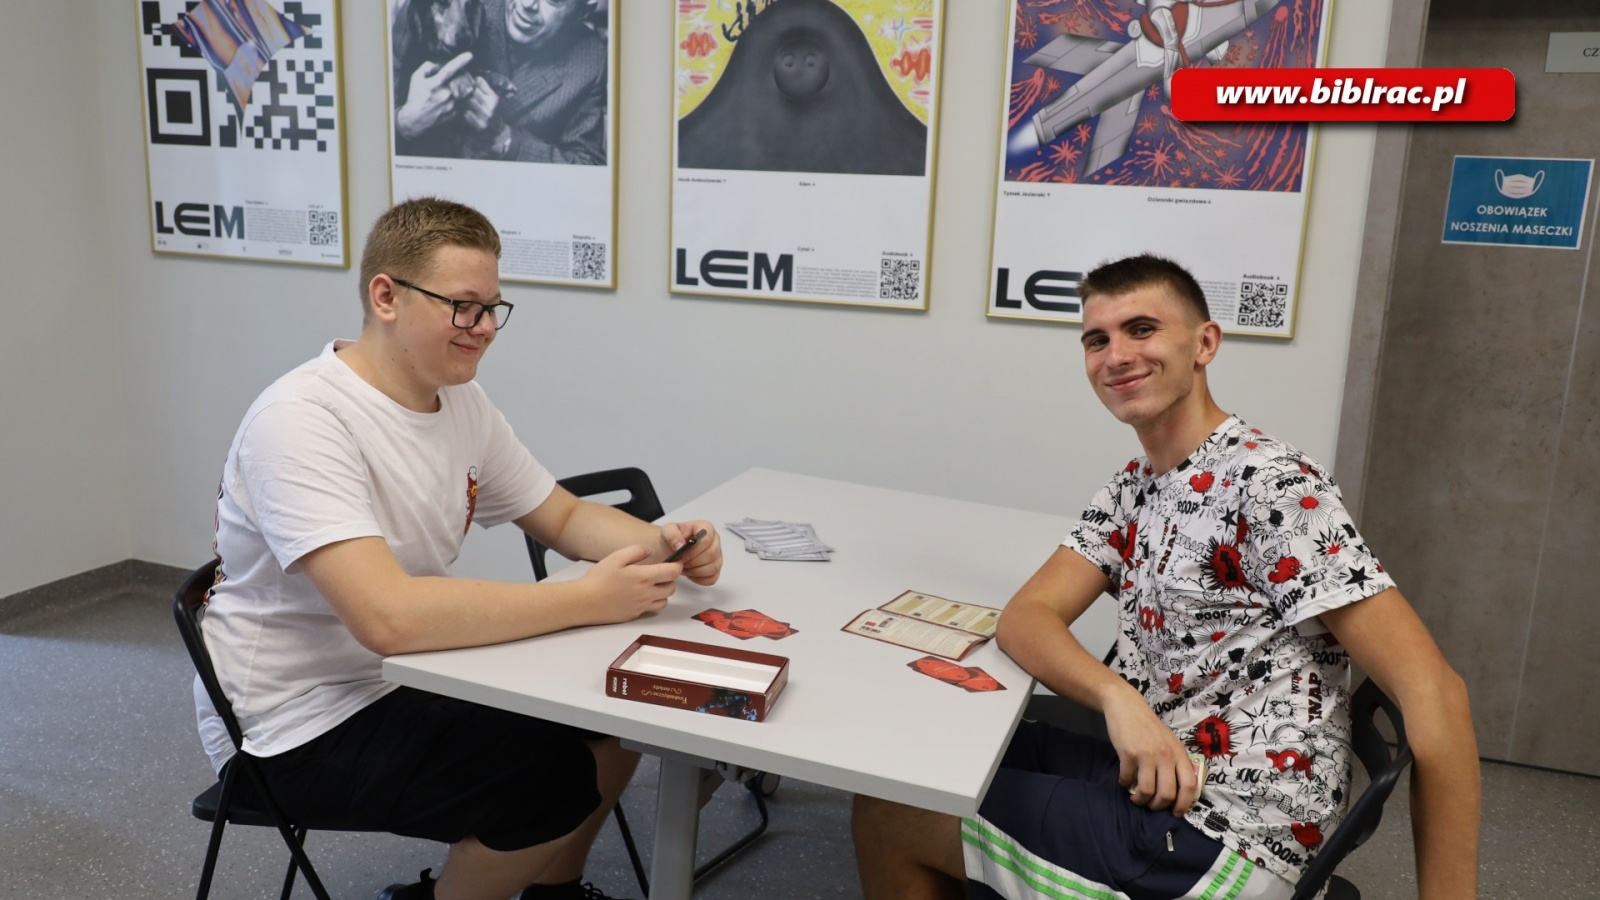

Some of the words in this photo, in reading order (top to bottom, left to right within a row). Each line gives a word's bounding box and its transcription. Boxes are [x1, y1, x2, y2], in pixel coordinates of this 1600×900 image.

[155, 201, 245, 240] LEM
[1450, 221, 1509, 234] NOSZENIA
[1512, 224, 1573, 236] MASECZKI
[1476, 205, 1548, 218] OBOWIĄZEK
[676, 248, 794, 292] LEM
[995, 267, 1083, 313] LE
